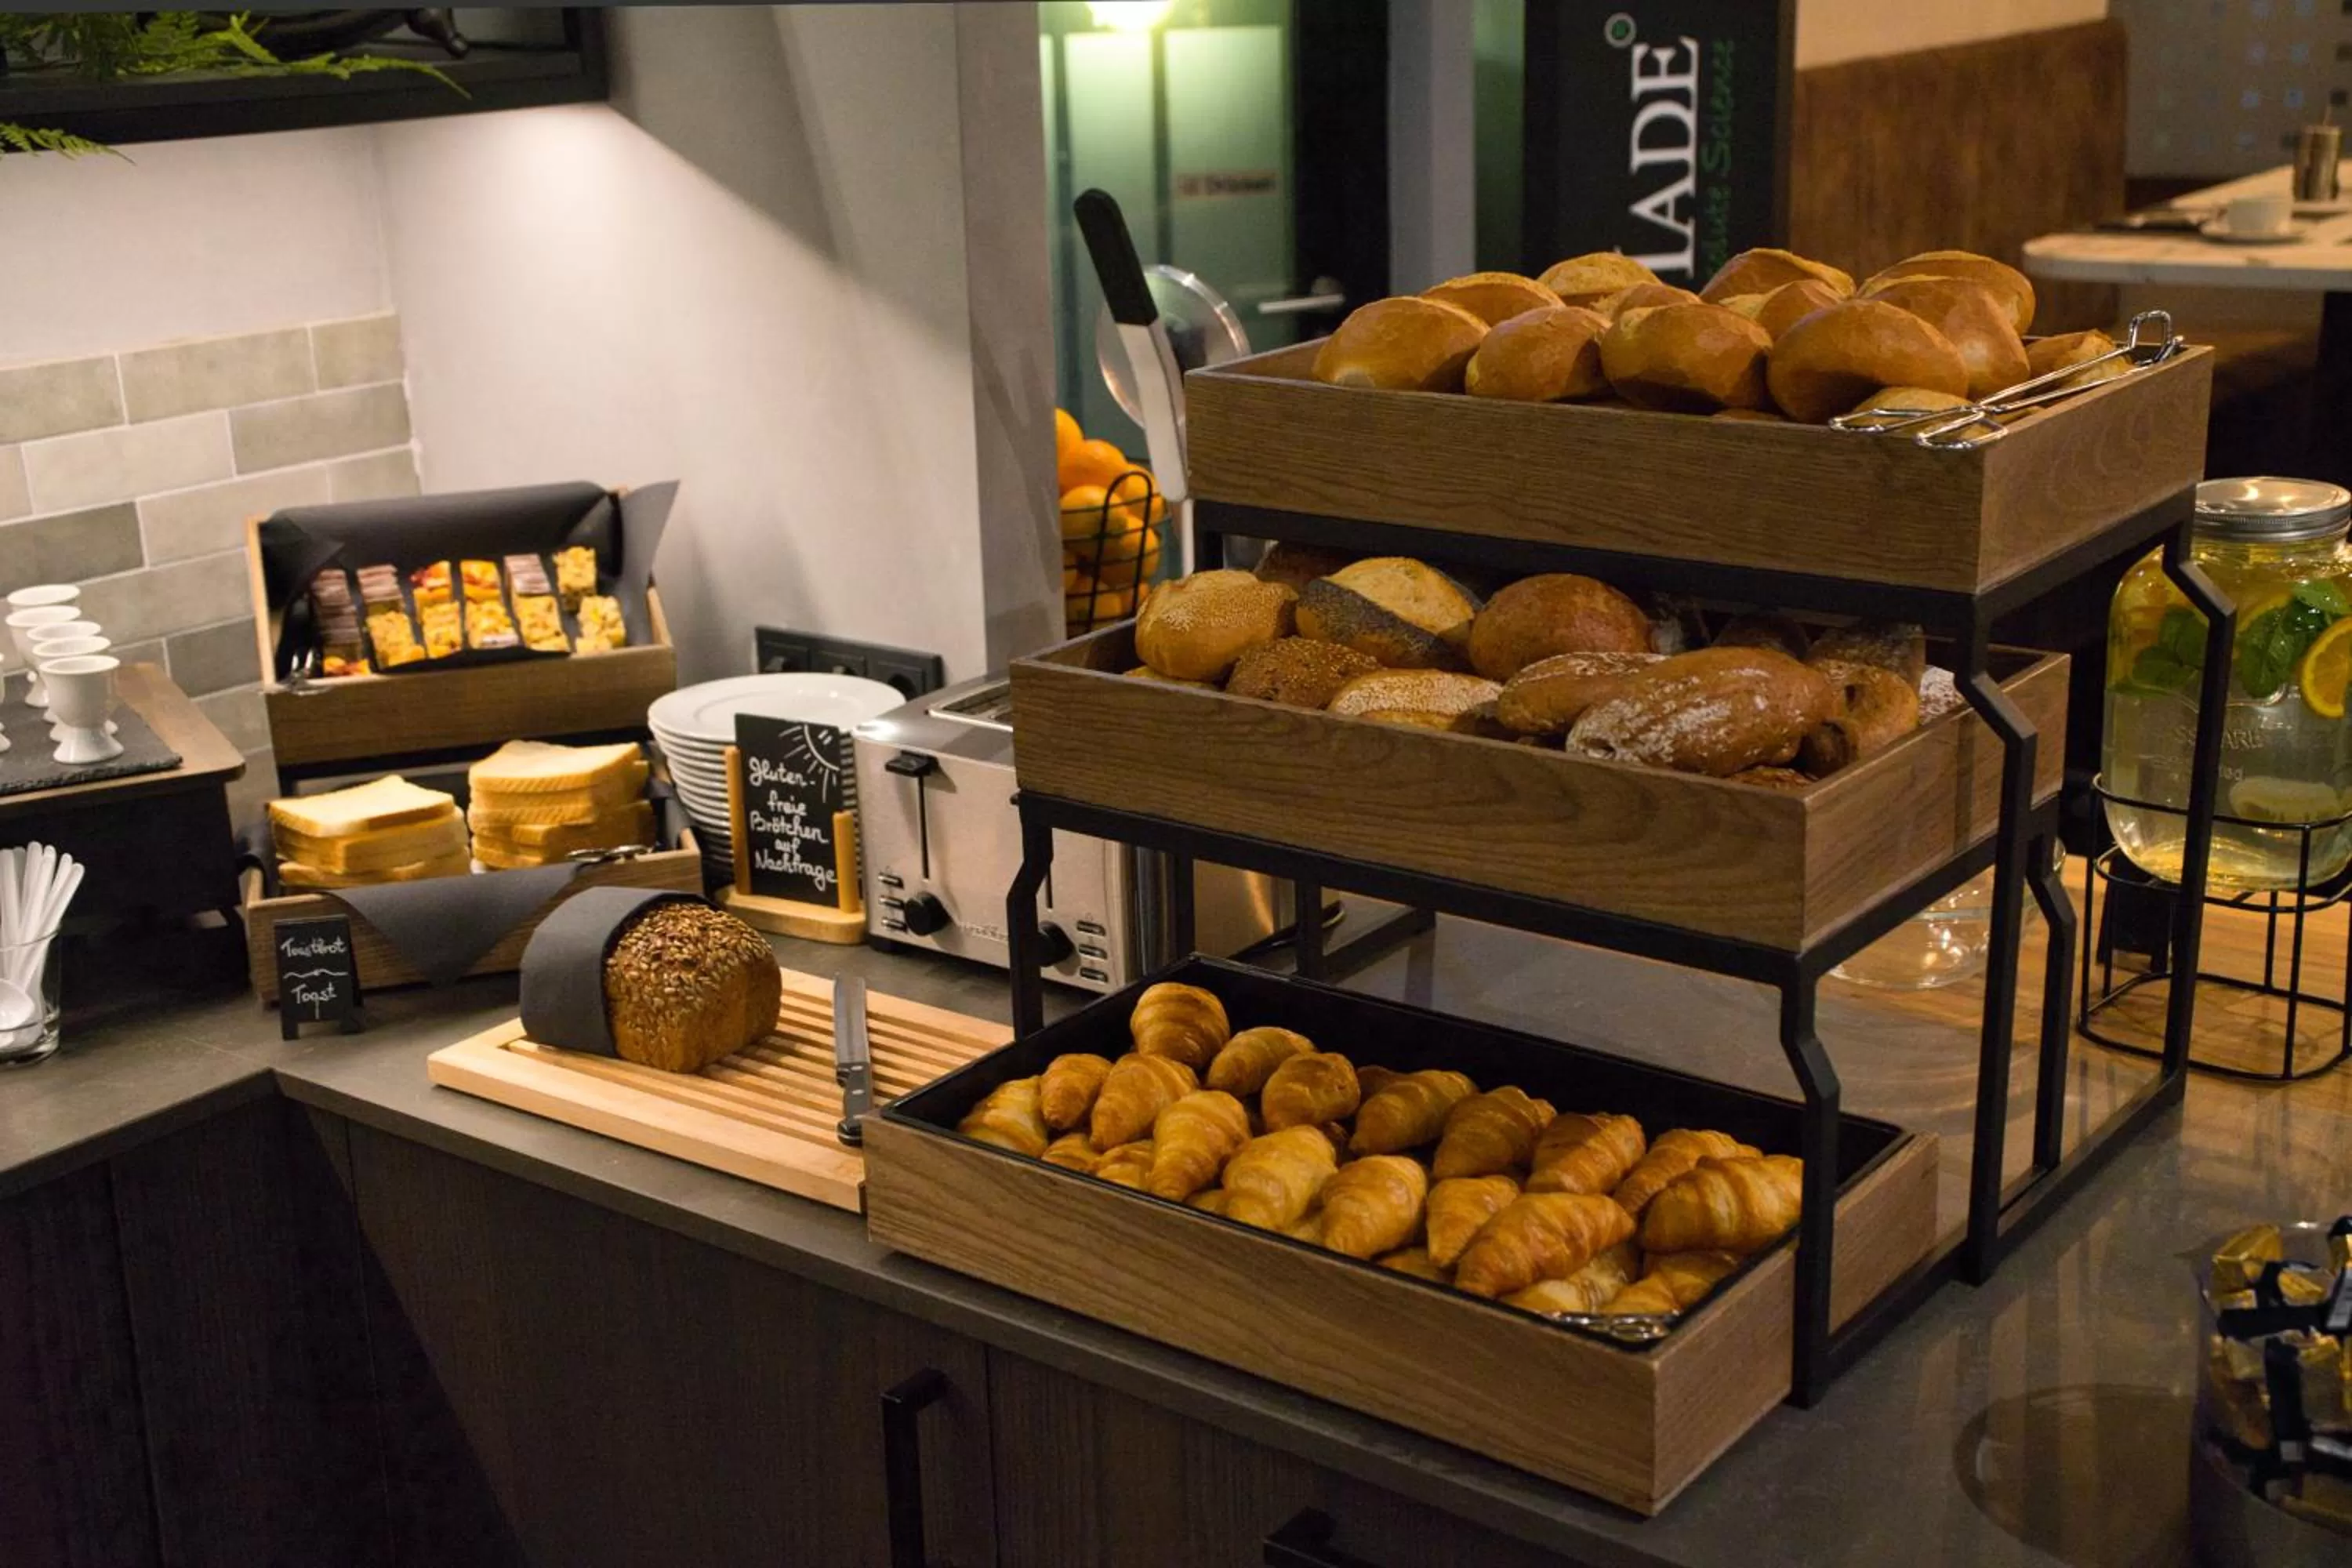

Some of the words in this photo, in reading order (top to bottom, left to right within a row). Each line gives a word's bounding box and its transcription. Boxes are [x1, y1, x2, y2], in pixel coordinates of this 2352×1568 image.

[768, 790, 808, 816] freie
[750, 811, 829, 844] Brötchen
[775, 837, 800, 855] auf
[754, 850, 839, 891] Nachfrage
[291, 982, 337, 1007] Toast
